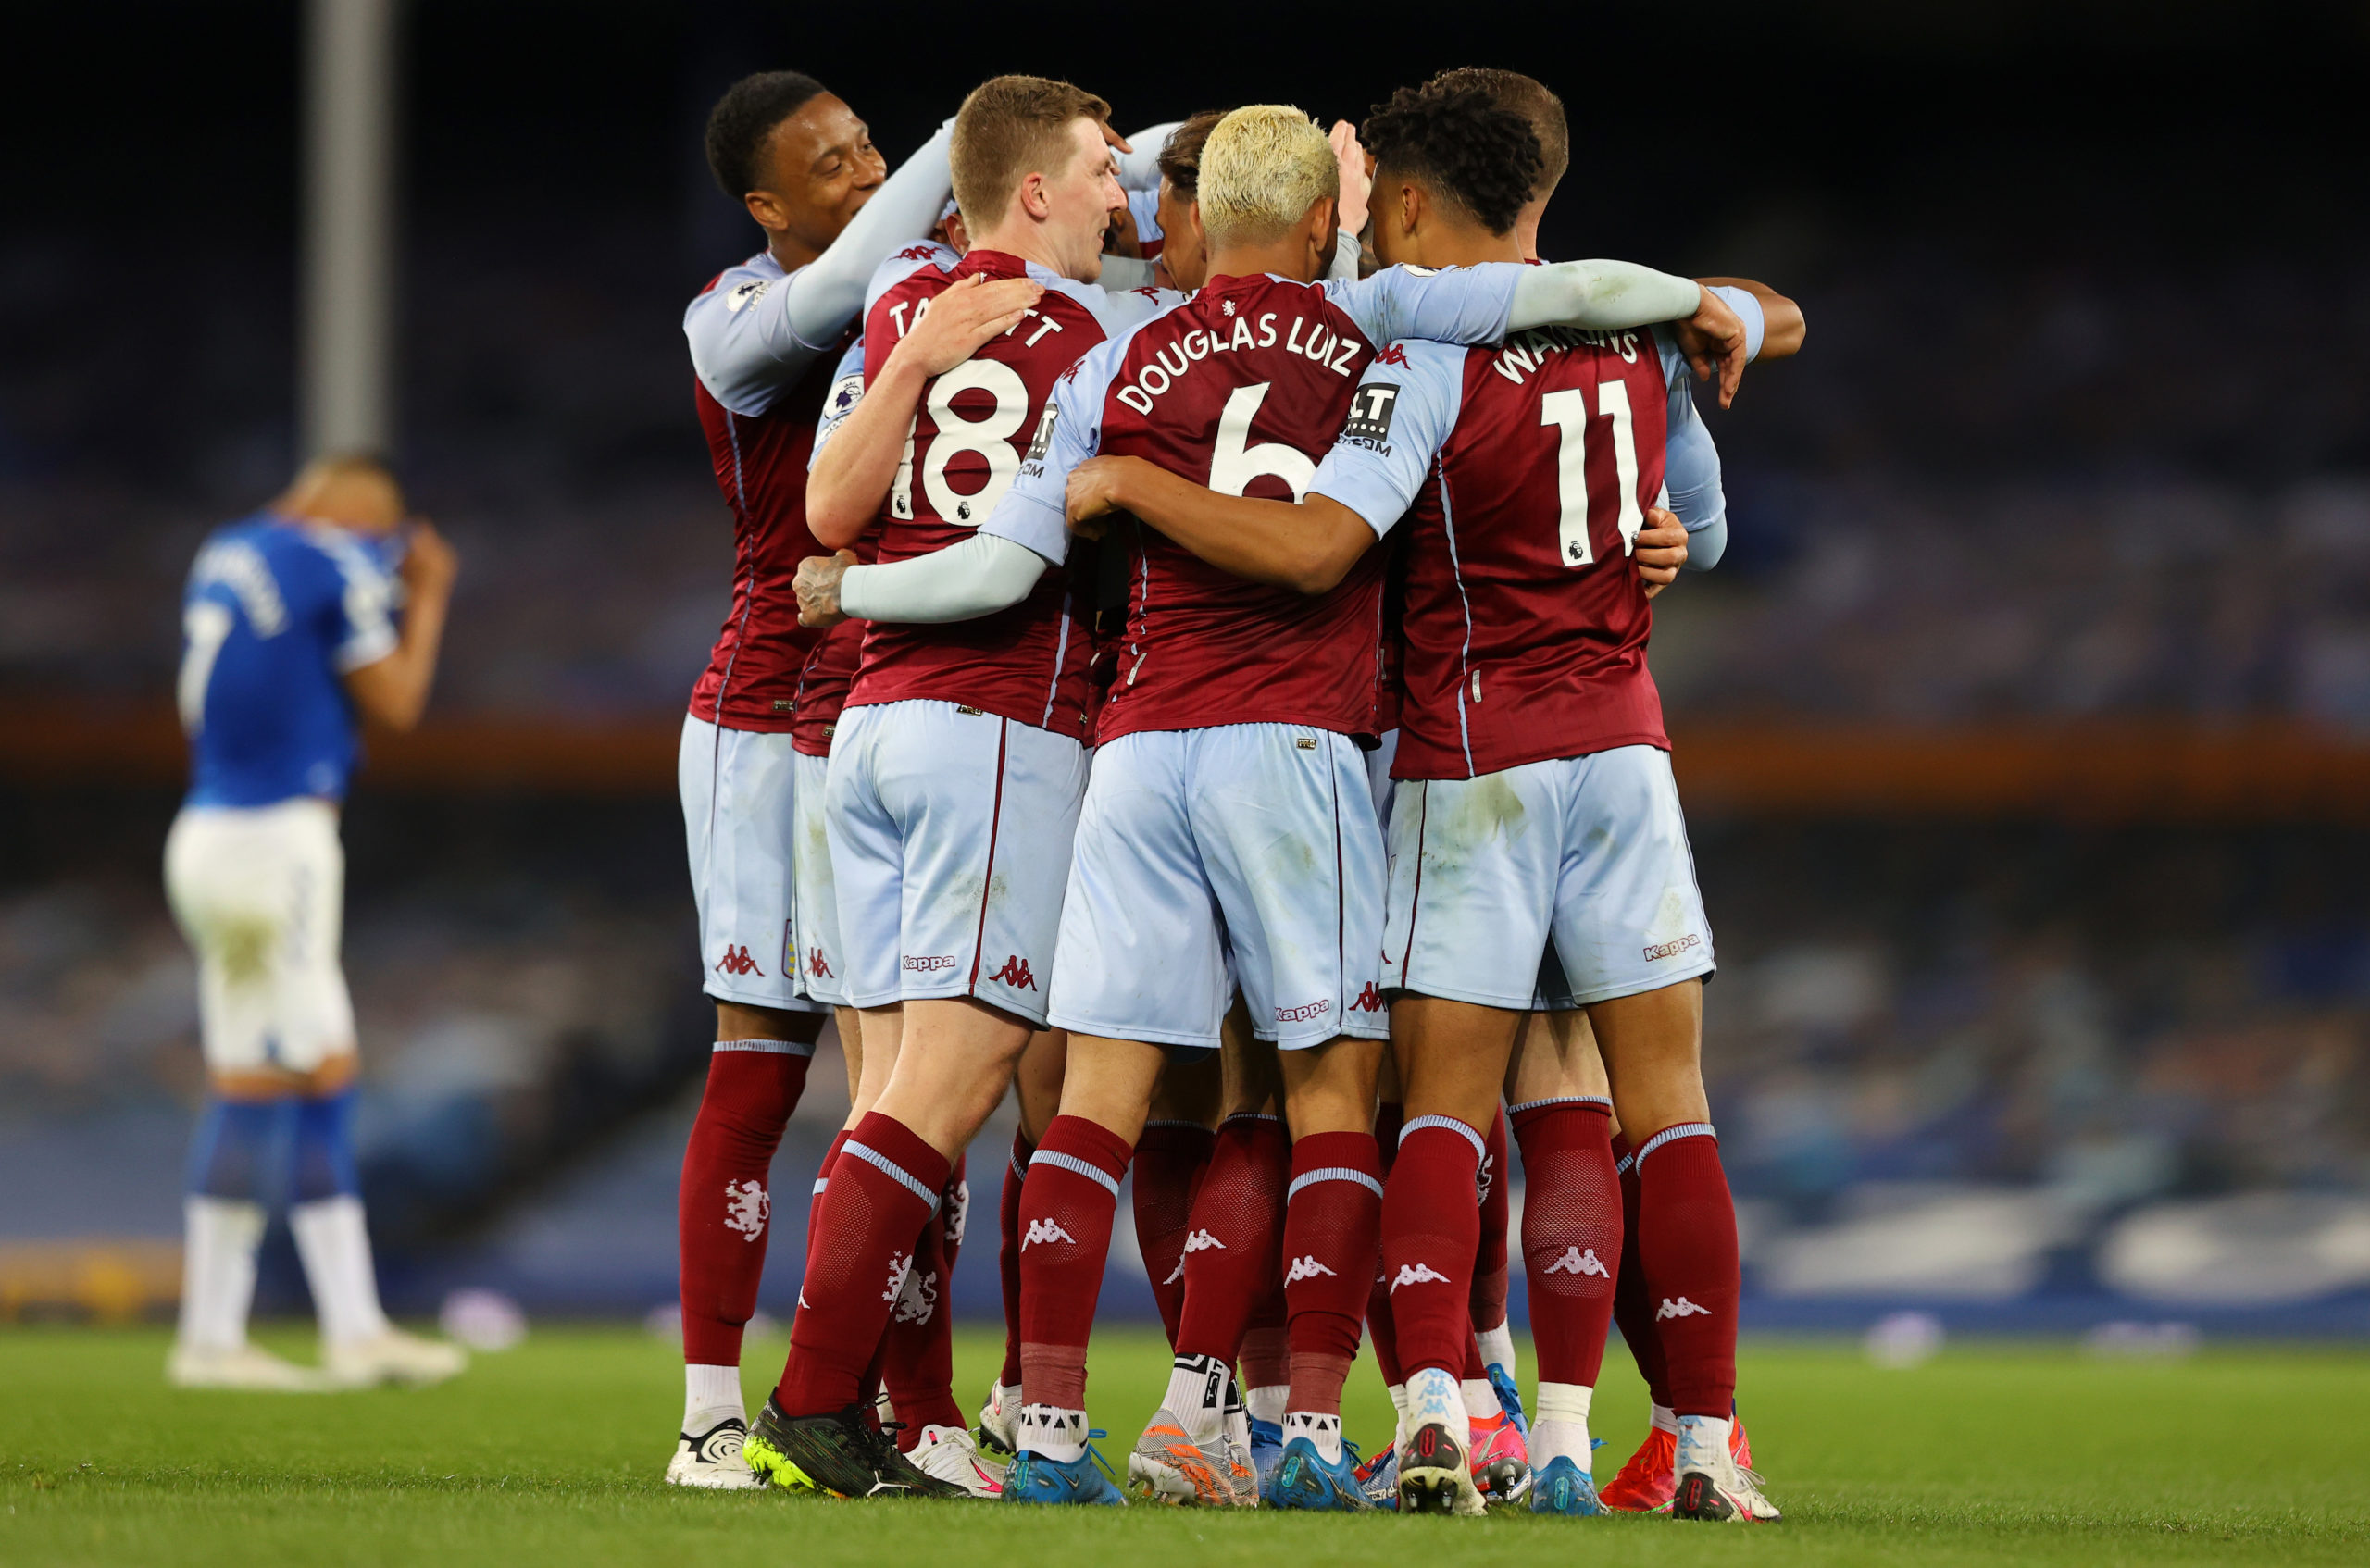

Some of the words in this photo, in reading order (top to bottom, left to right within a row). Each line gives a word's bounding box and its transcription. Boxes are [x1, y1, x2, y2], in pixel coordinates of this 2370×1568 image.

[1116, 313, 1278, 416] DOUGLAS
[1285, 316, 1361, 377] LUIZ
[1208, 381, 1317, 505] 6
[1540, 379, 1644, 567] 11
[903, 955, 955, 972] Kappa
[1642, 934, 1700, 962] Kappa
[1274, 999, 1329, 1022] Kappa
